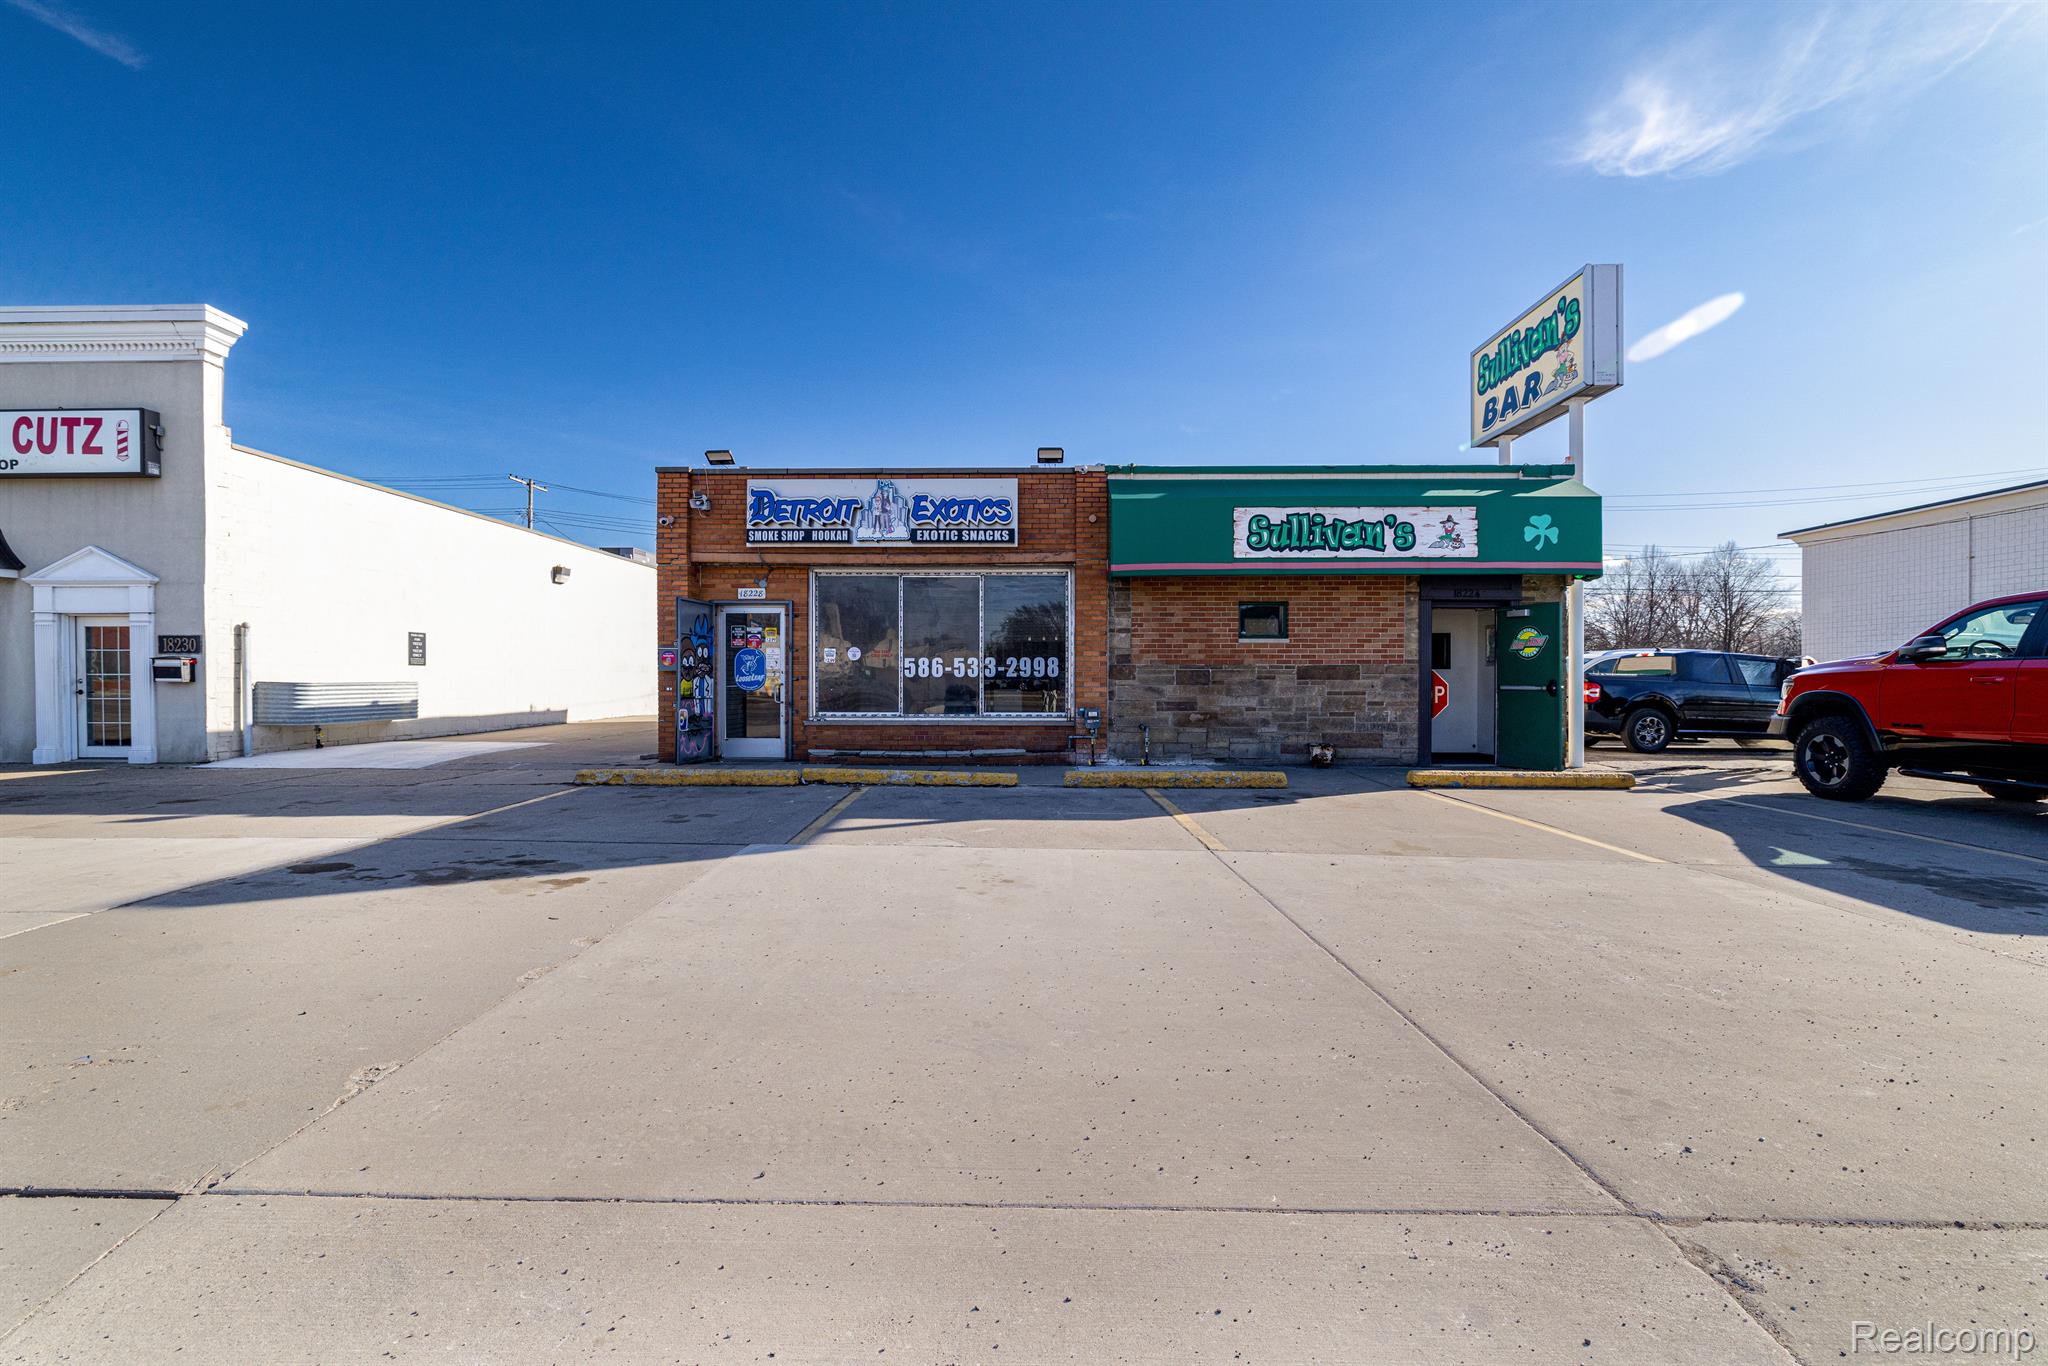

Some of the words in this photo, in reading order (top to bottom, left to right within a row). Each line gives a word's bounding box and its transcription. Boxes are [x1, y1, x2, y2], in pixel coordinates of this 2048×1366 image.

[1477, 296, 1581, 396] Sullivan's
[1482, 371, 1544, 432] BAR
[12, 416, 103, 455] CUTZ
[0, 459, 19, 470] OP
[748, 530, 779, 541] SMOKE
[781, 530, 805, 541] SHOP
[812, 530, 848, 541] HOOKAH
[916, 530, 959, 541] EXOTIC
[962, 530, 1010, 541] SNACKS
[1247, 512, 1417, 552] Sullivan's
[739, 590, 764, 598] 18228
[163, 637, 197, 652] 18230
[904, 656, 1059, 678] 586-533-2998
